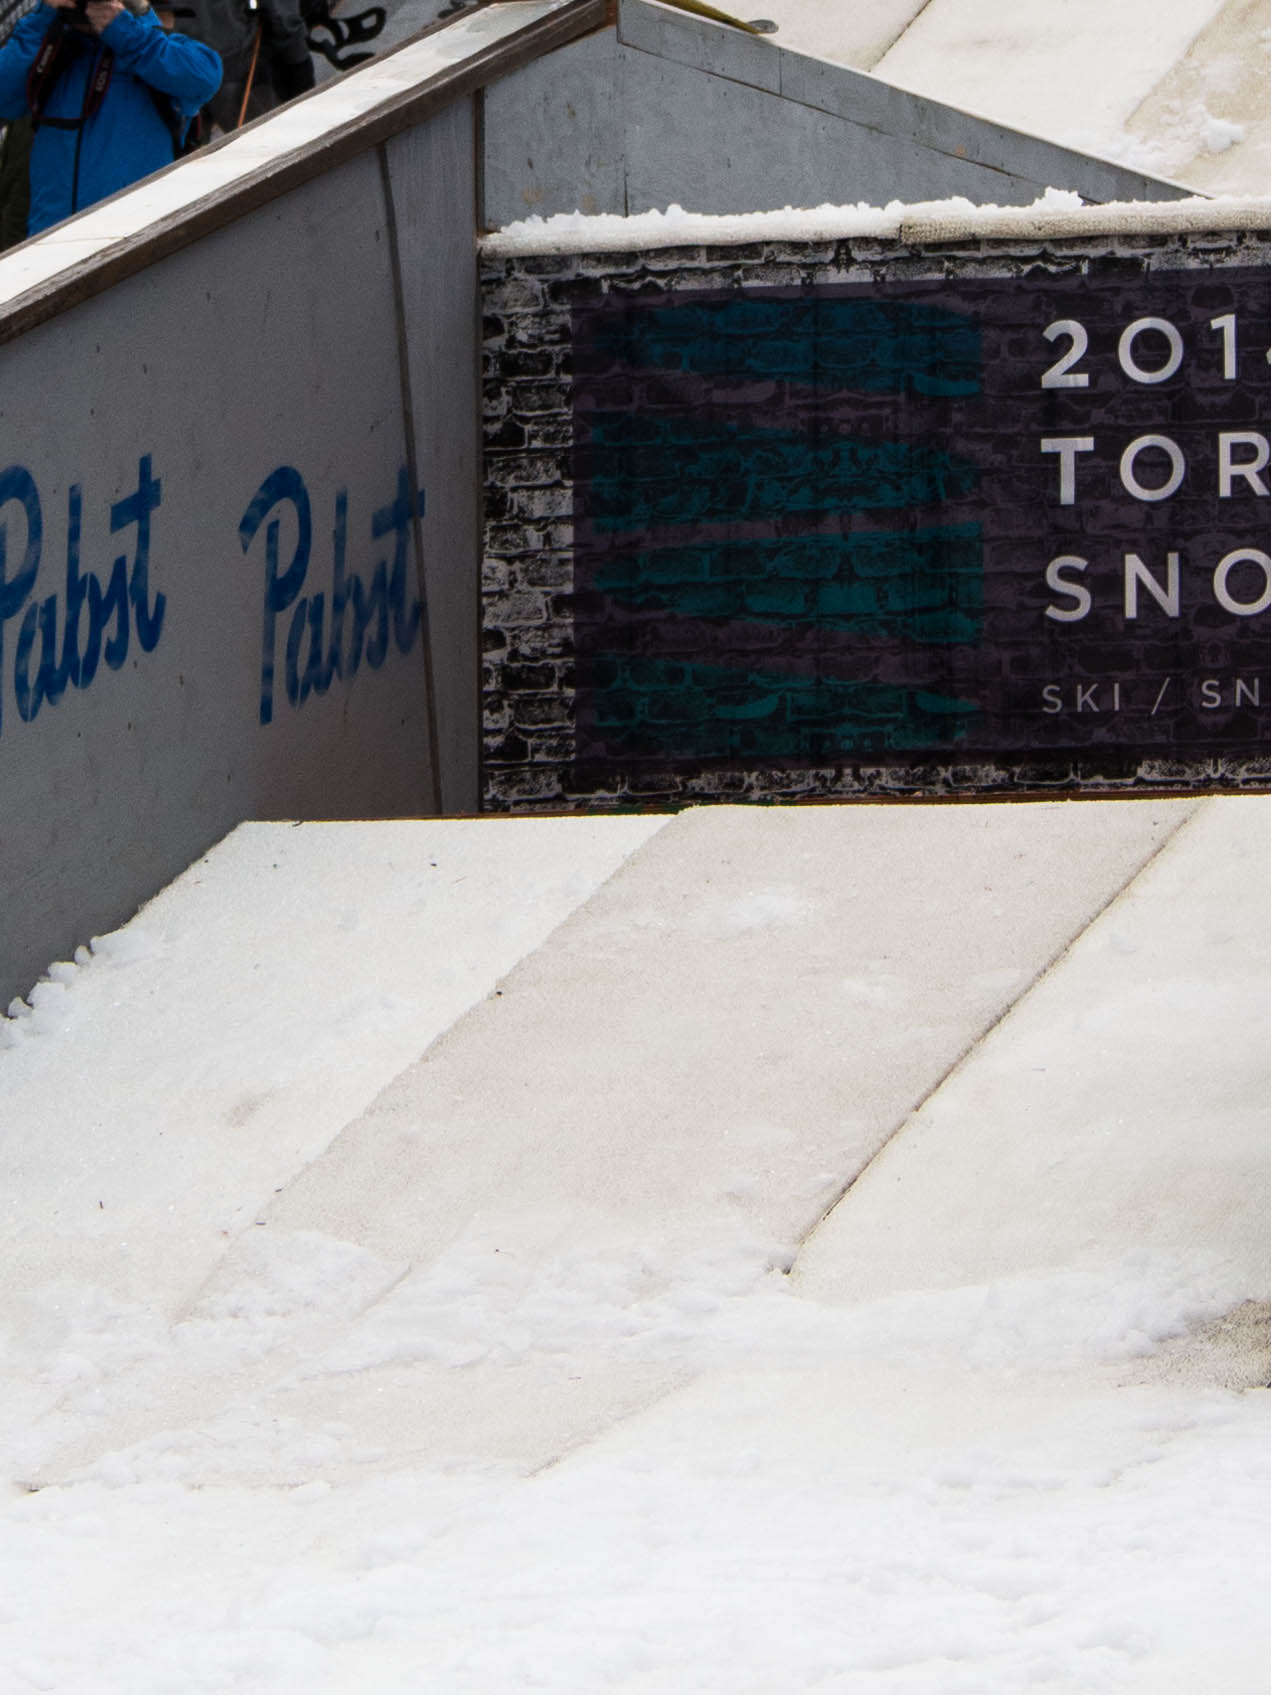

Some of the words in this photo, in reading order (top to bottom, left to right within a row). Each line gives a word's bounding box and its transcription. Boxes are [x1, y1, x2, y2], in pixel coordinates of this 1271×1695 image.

[1040, 313, 1271, 389] 201
[237, 463, 426, 727] Pabst
[1041, 681, 1120, 714] SKI
[1200, 676, 1261, 709] SN
